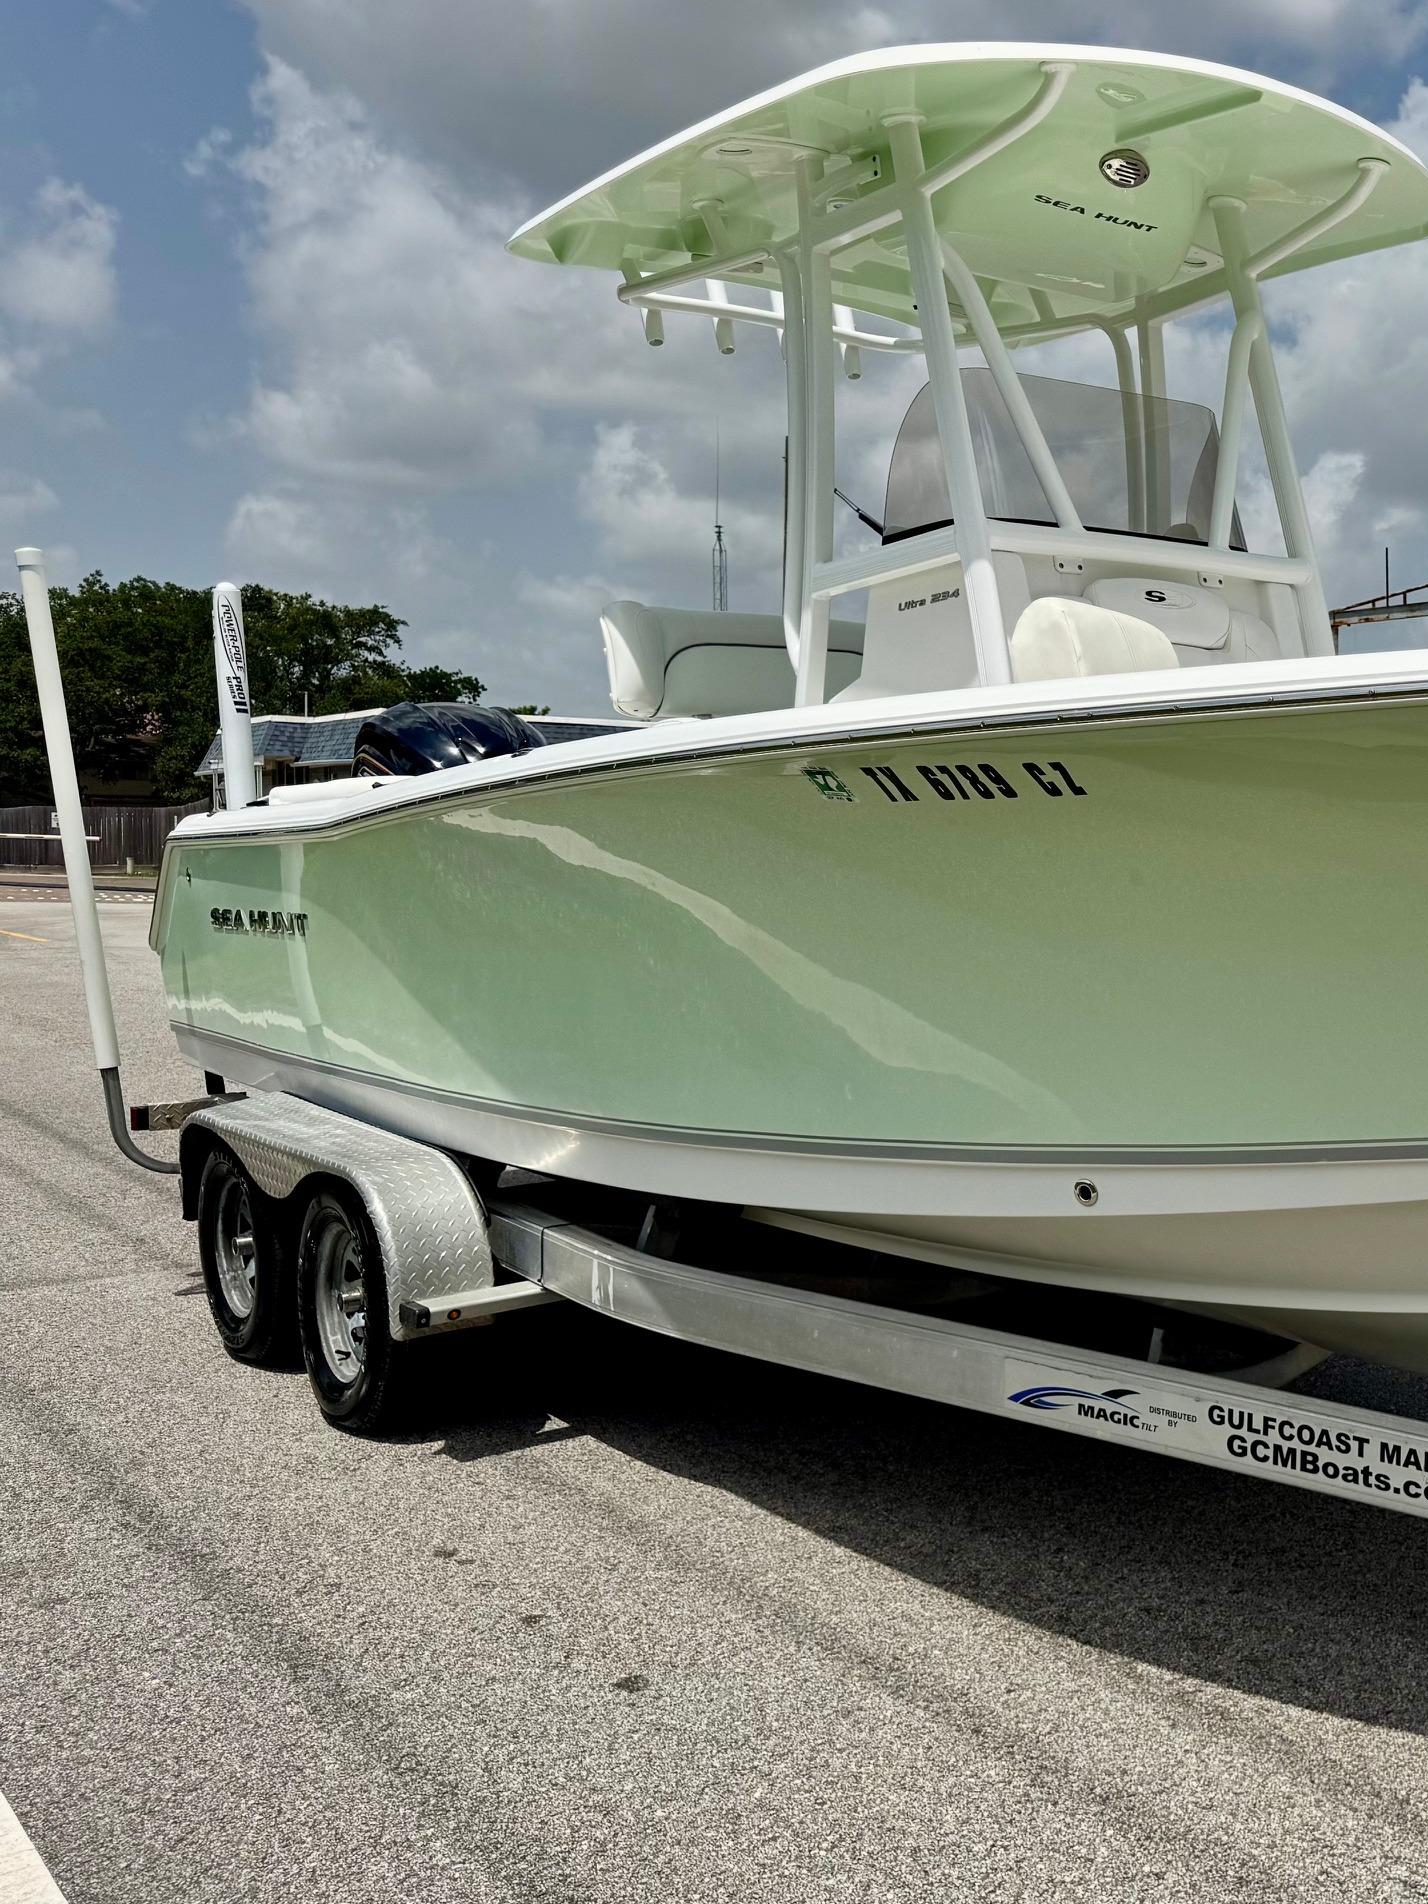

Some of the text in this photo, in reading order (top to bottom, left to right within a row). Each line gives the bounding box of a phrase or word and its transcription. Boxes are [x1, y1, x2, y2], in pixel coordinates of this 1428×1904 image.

[1034, 194, 1158, 232] SEA HUNT
[898, 588, 960, 611] Ultra 234
[221, 604, 244, 672] POWER-POLE
[226, 676, 238, 700] SERIES
[232, 676, 246, 700] PRO
[859, 766, 920, 802] TX
[915, 763, 1018, 800] 6789
[1021, 761, 1089, 797] CZ
[210, 907, 308, 937] SEA HUNT
[1077, 1402, 1159, 1433] MAGIC TILT
[1149, 1405, 1197, 1423] DISTRIBUTED
[1167, 1419, 1178, 1428] BY
[1207, 1404, 1370, 1458] GULFCOAST
